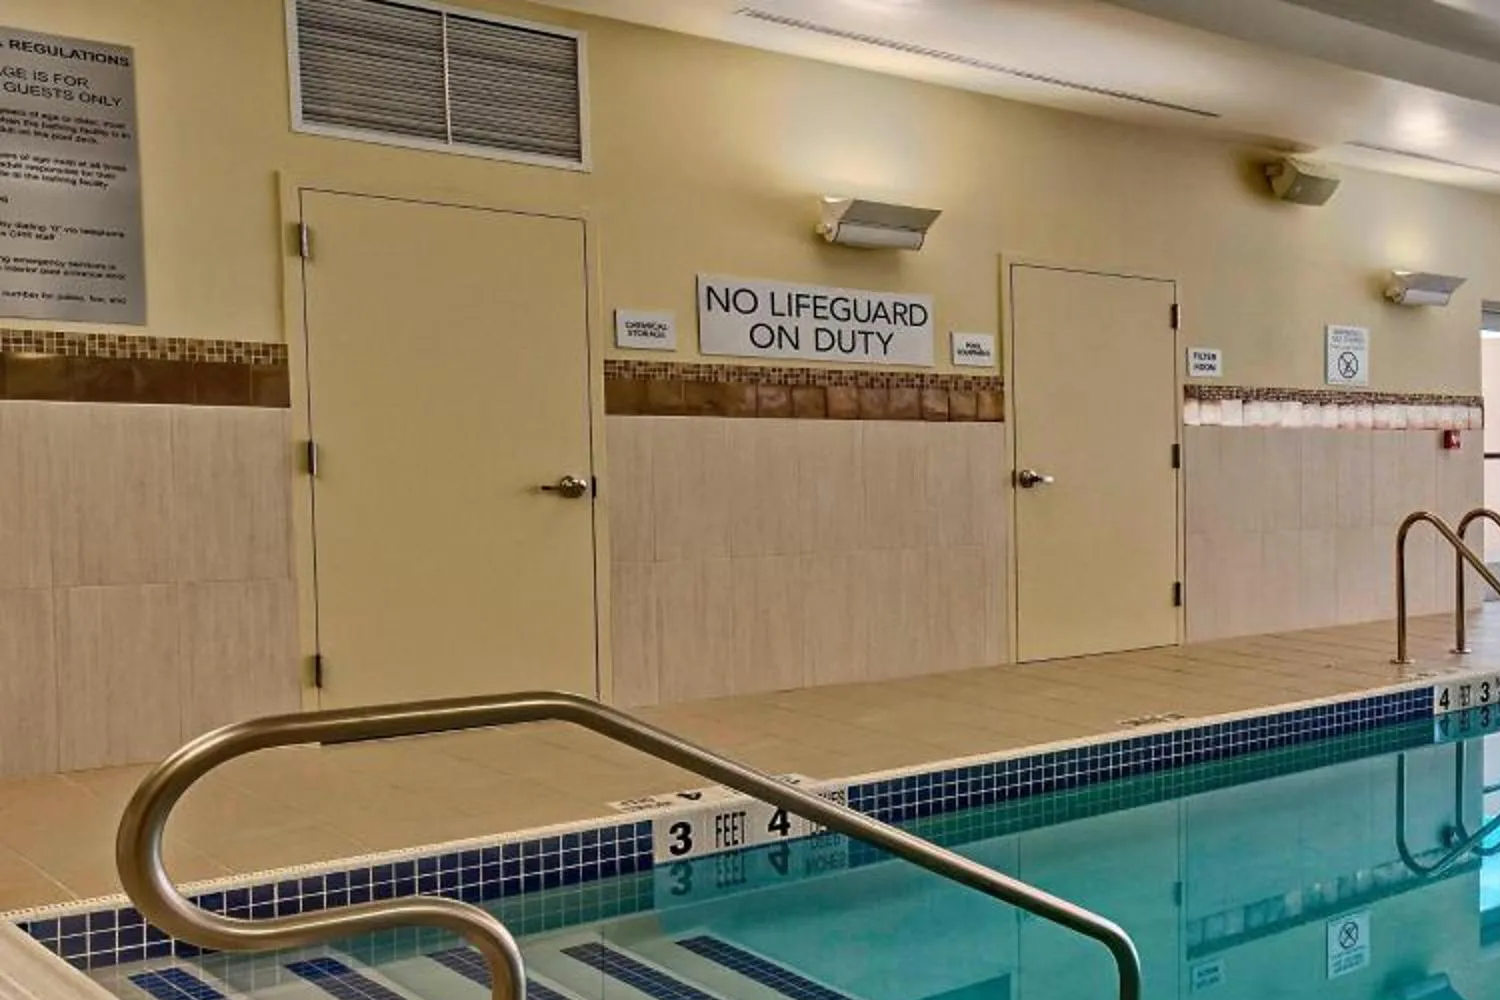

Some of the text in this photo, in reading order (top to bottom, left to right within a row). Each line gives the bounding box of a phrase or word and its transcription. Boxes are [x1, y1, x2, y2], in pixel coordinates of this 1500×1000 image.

[9, 39, 130, 67] REGULATIONS
[0, 65, 89, 89] GE IS FOR
[3, 81, 122, 107] GUESTS ONLY
[706, 286, 929, 327] NO LIFEGUARD
[748, 323, 896, 356] ON DUTY
[1439, 687, 1449, 710] 4
[1481, 681, 1491, 702] 3
[669, 806, 791, 856] 3 FEET 4
